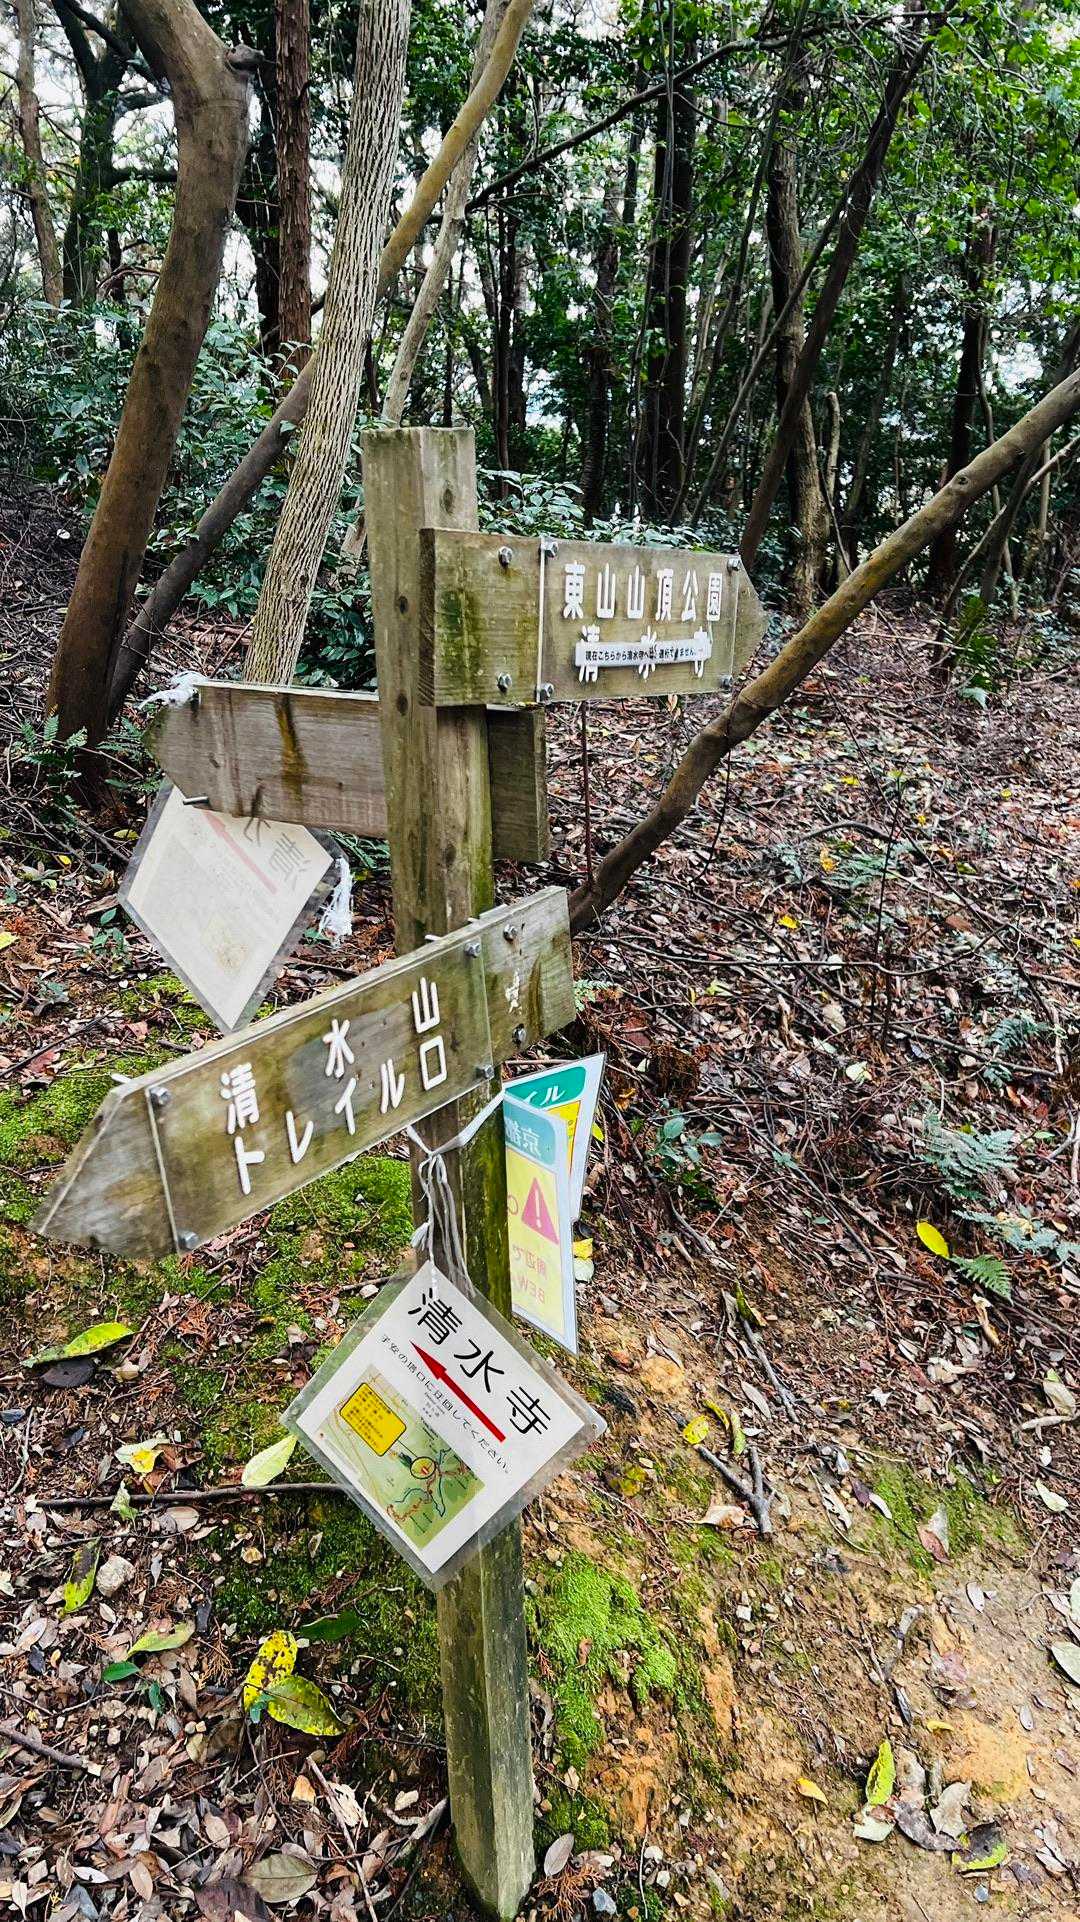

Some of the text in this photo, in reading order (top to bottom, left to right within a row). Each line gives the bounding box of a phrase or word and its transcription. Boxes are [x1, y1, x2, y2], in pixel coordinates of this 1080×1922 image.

[562, 559, 723, 622] 東山山頂公園
[407, 1287, 551, 1436] 清水寺
